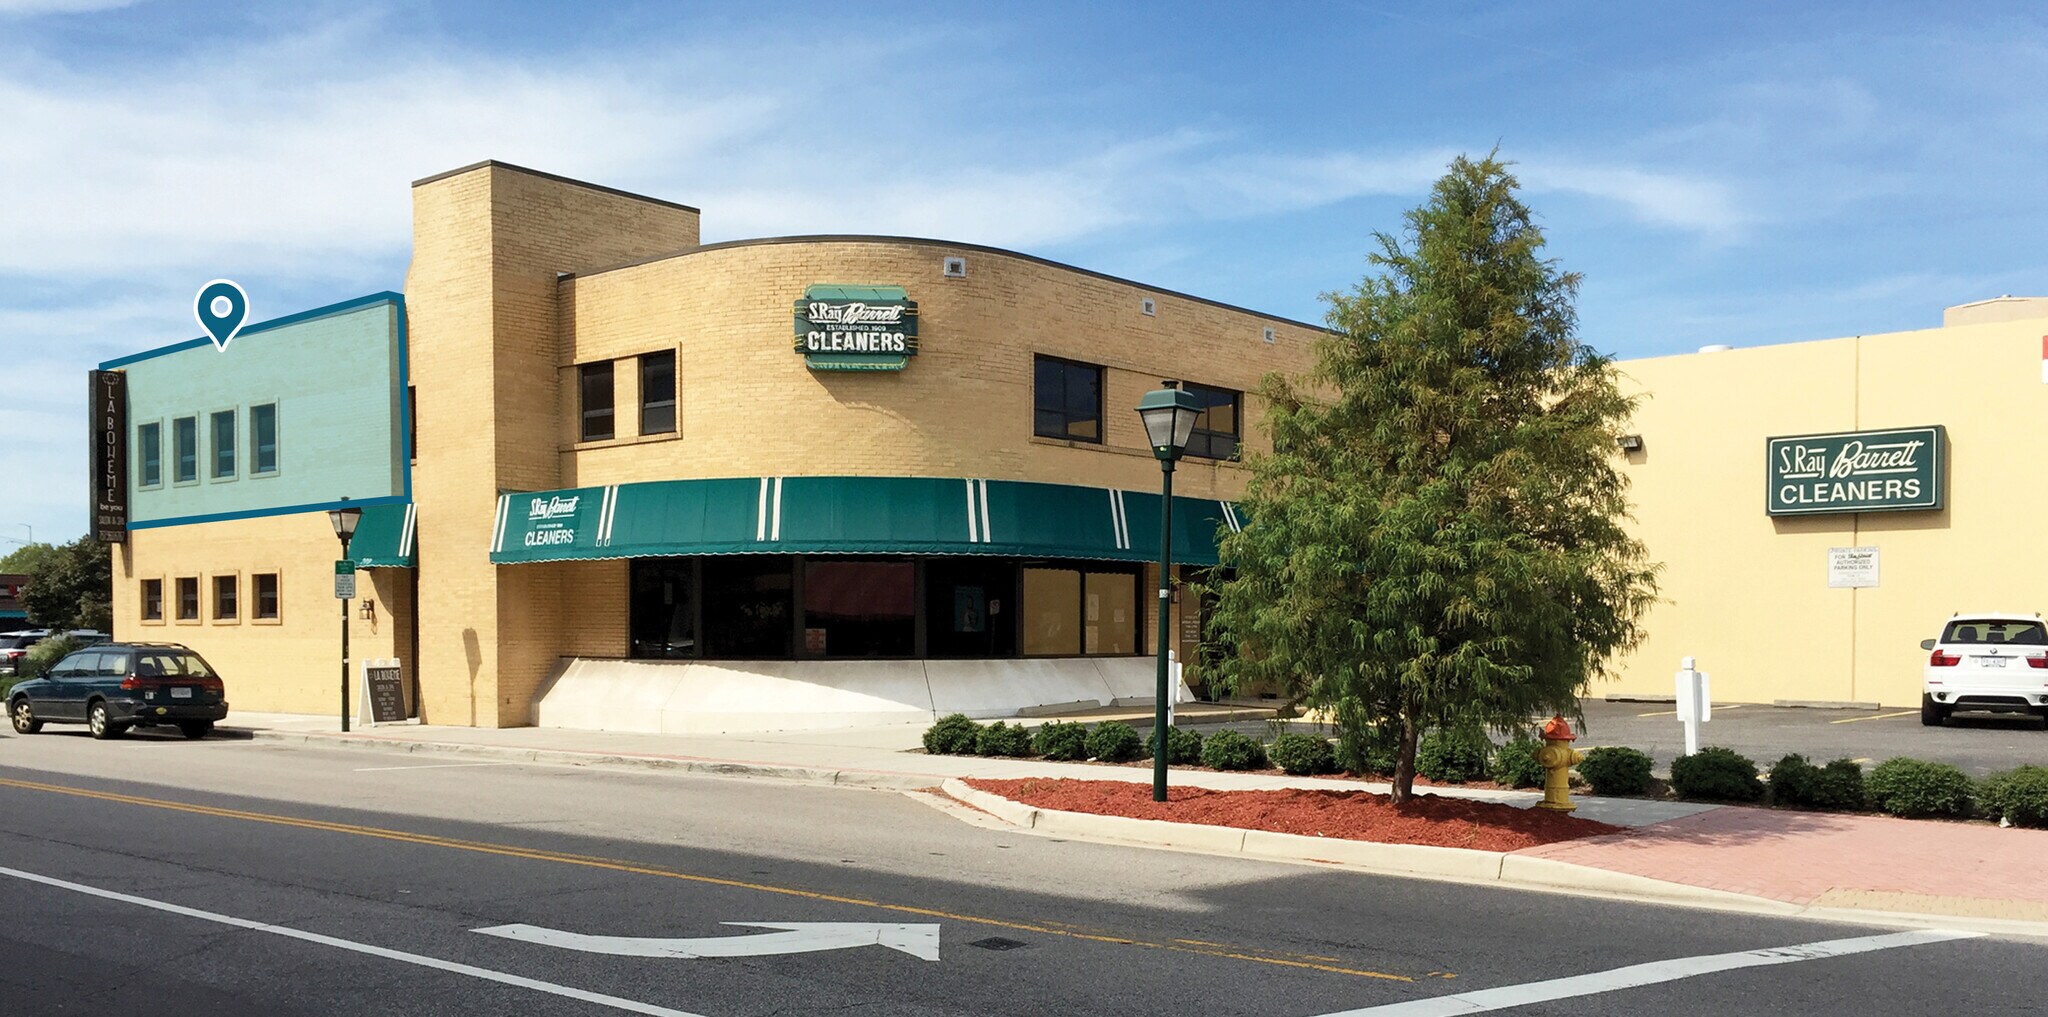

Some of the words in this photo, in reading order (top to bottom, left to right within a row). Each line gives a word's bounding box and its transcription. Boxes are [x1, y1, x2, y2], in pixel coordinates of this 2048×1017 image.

[842, 302, 905, 325] Barrett
[826, 324, 869, 332] ESTABLISHED
[807, 331, 905, 352] CLEANERS
[107, 385, 115, 413] LA
[106, 416, 116, 502] BOHEME
[1829, 440, 1925, 479] Barrett
[1780, 478, 1921, 504] CLEANERS
[100, 502, 109, 511] be
[525, 529, 575, 547] CLEANERS
